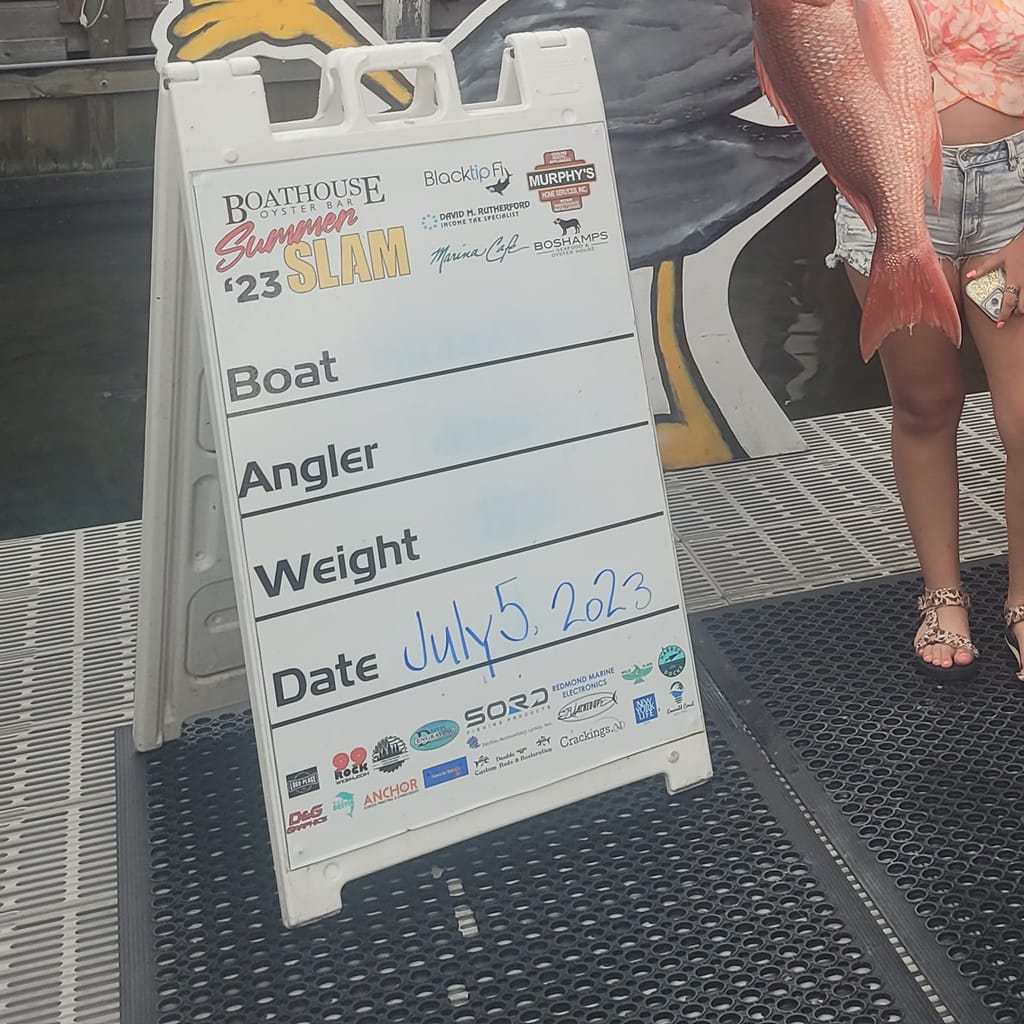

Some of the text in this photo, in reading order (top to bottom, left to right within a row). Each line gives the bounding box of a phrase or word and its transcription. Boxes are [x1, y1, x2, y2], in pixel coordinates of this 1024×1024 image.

[423, 164, 491, 187] Blacktip
[528, 167, 595, 188] MURPHY'S
[222, 175, 386, 225] BOATHOUSE
[259, 198, 355, 219] OYSTER BAR
[439, 200, 531, 220] DAVID M. RUTHERFORD
[440, 211, 520, 228] INCOME TAX SPECIALIST
[214, 207, 359, 273] Summer
[533, 231, 609, 251] BOSHAMPS
[283, 225, 412, 294] SLAM
[430, 242, 487, 275] Marina
[227, 350, 339, 403] Boat
[238, 442, 379, 499] Angler
[254, 528, 421, 599] Weight
[403, 599, 497, 679] July
[550, 568, 654, 632] 2023
[272, 652, 380, 708] Date
[551, 666, 615, 692] REDMOND MARINE
[562, 678, 608, 698] ELECTRONICS
[635, 703, 655, 713] YORK
[636, 697, 653, 707] NEW
[637, 710, 656, 722] LIFE
[334, 763, 369, 780] ROCK
[474, 764, 498, 777] Custom
[520, 747, 553, 762] Restoration
[363, 778, 418, 806] ANCHOR
[286, 815, 329, 835] GRAPHICS
[288, 802, 324, 826] D&G
